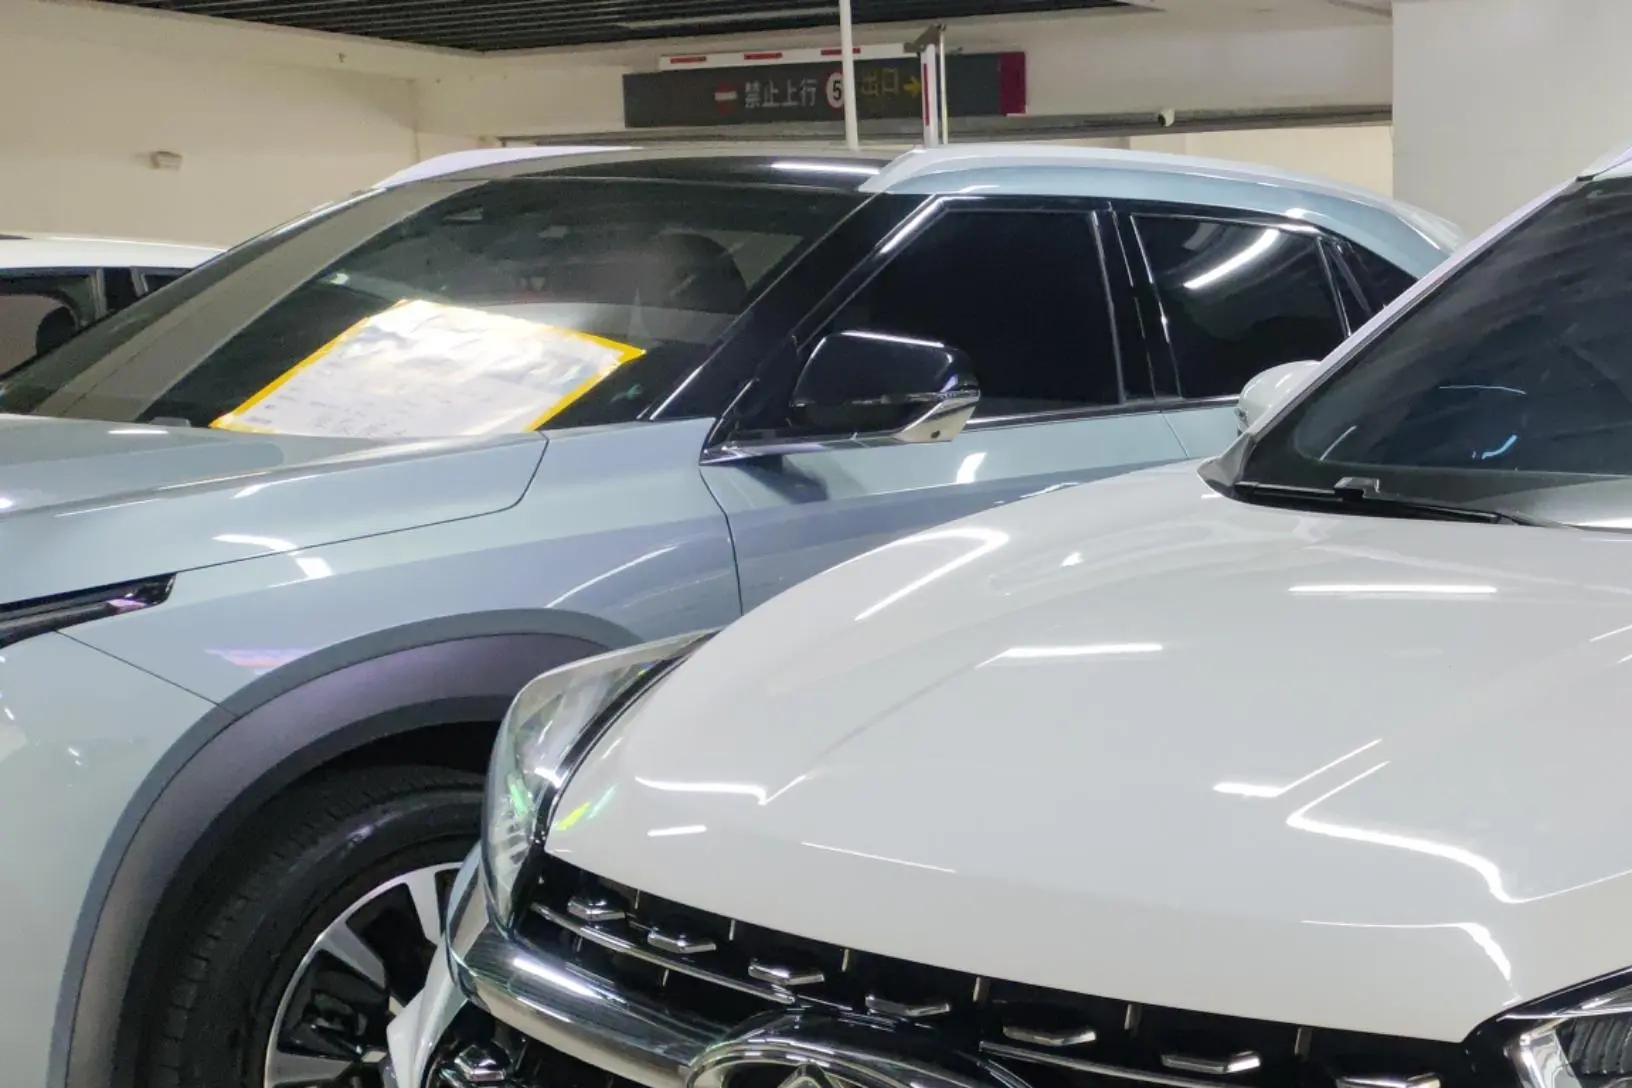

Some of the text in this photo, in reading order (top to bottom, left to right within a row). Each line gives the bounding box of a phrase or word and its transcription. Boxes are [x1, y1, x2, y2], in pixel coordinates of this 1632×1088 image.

[744, 77, 818, 108] 禁止上行
[832, 79, 842, 101] 5
[862, 67, 900, 96] 出口
